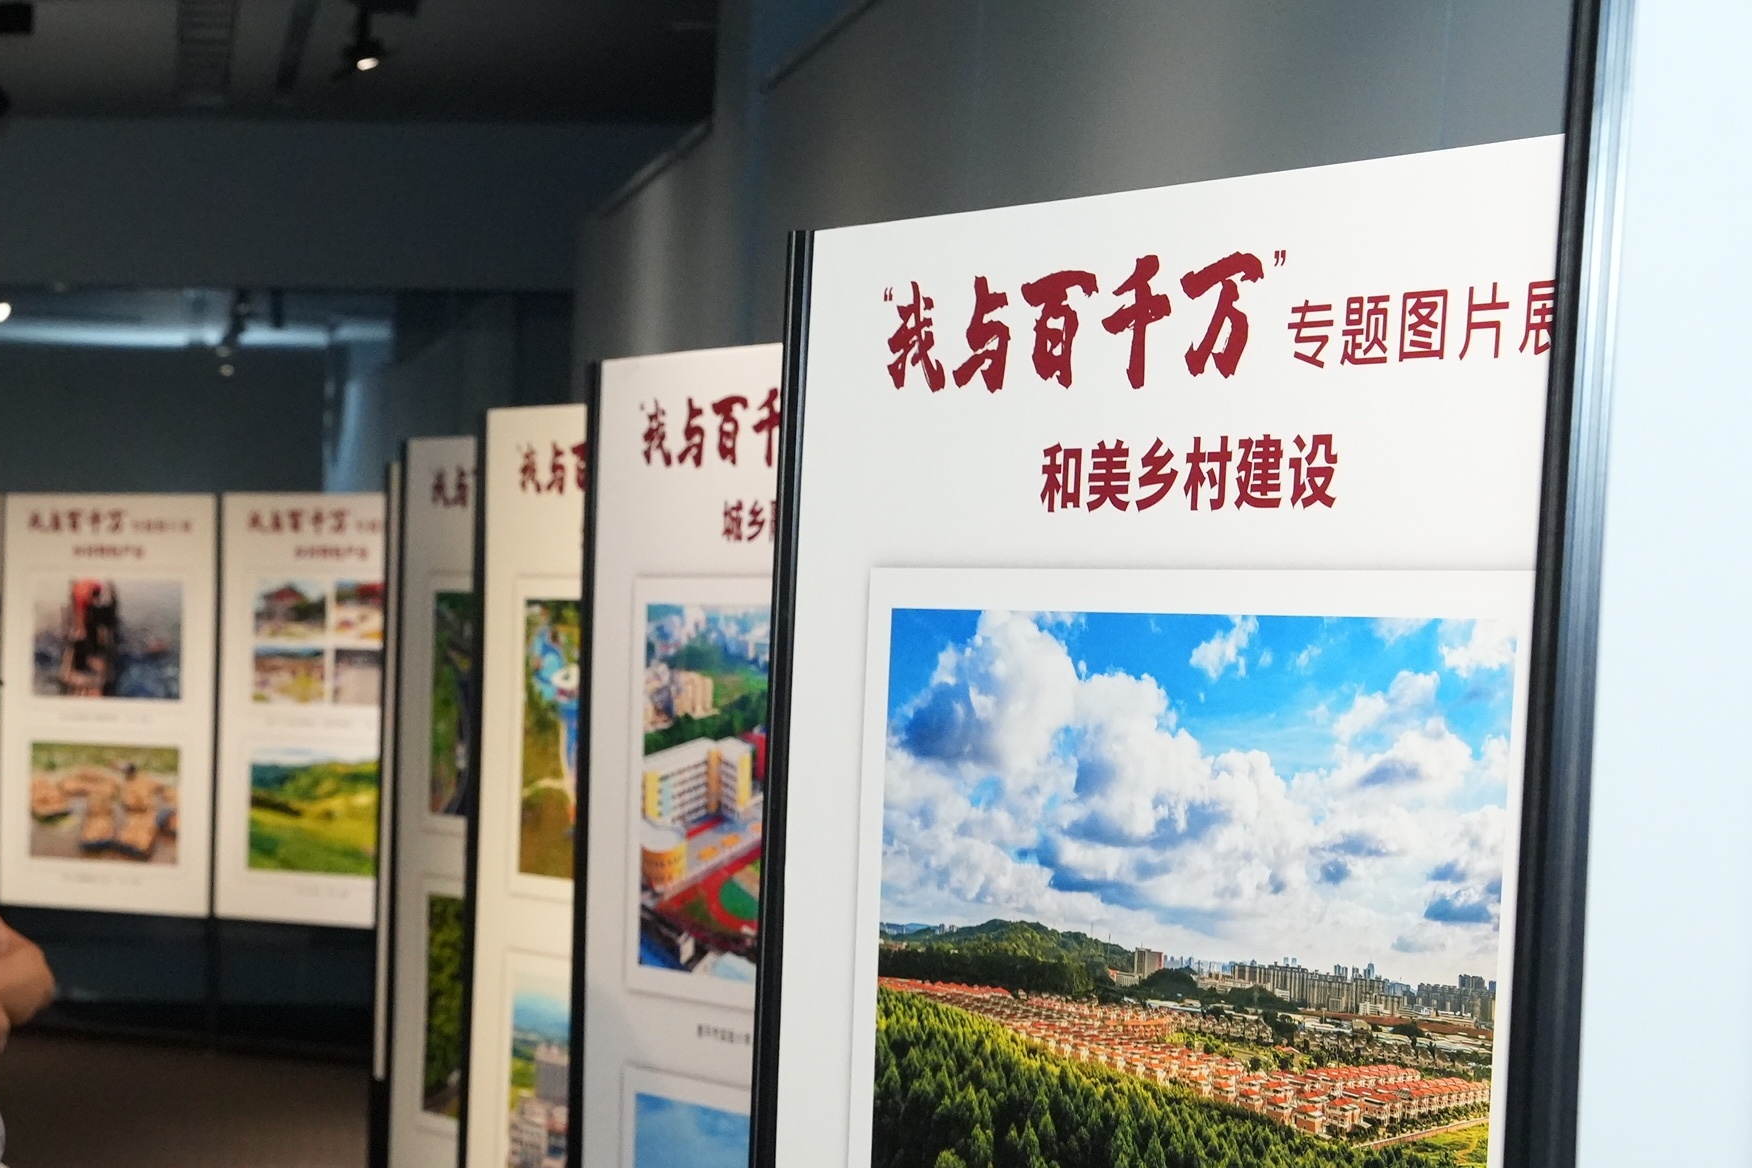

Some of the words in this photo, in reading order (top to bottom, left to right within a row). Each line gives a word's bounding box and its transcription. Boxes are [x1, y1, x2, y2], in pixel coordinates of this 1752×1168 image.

[1040, 433, 1339, 513] 和美乡村建设
[722, 499, 777, 542] 城乡
